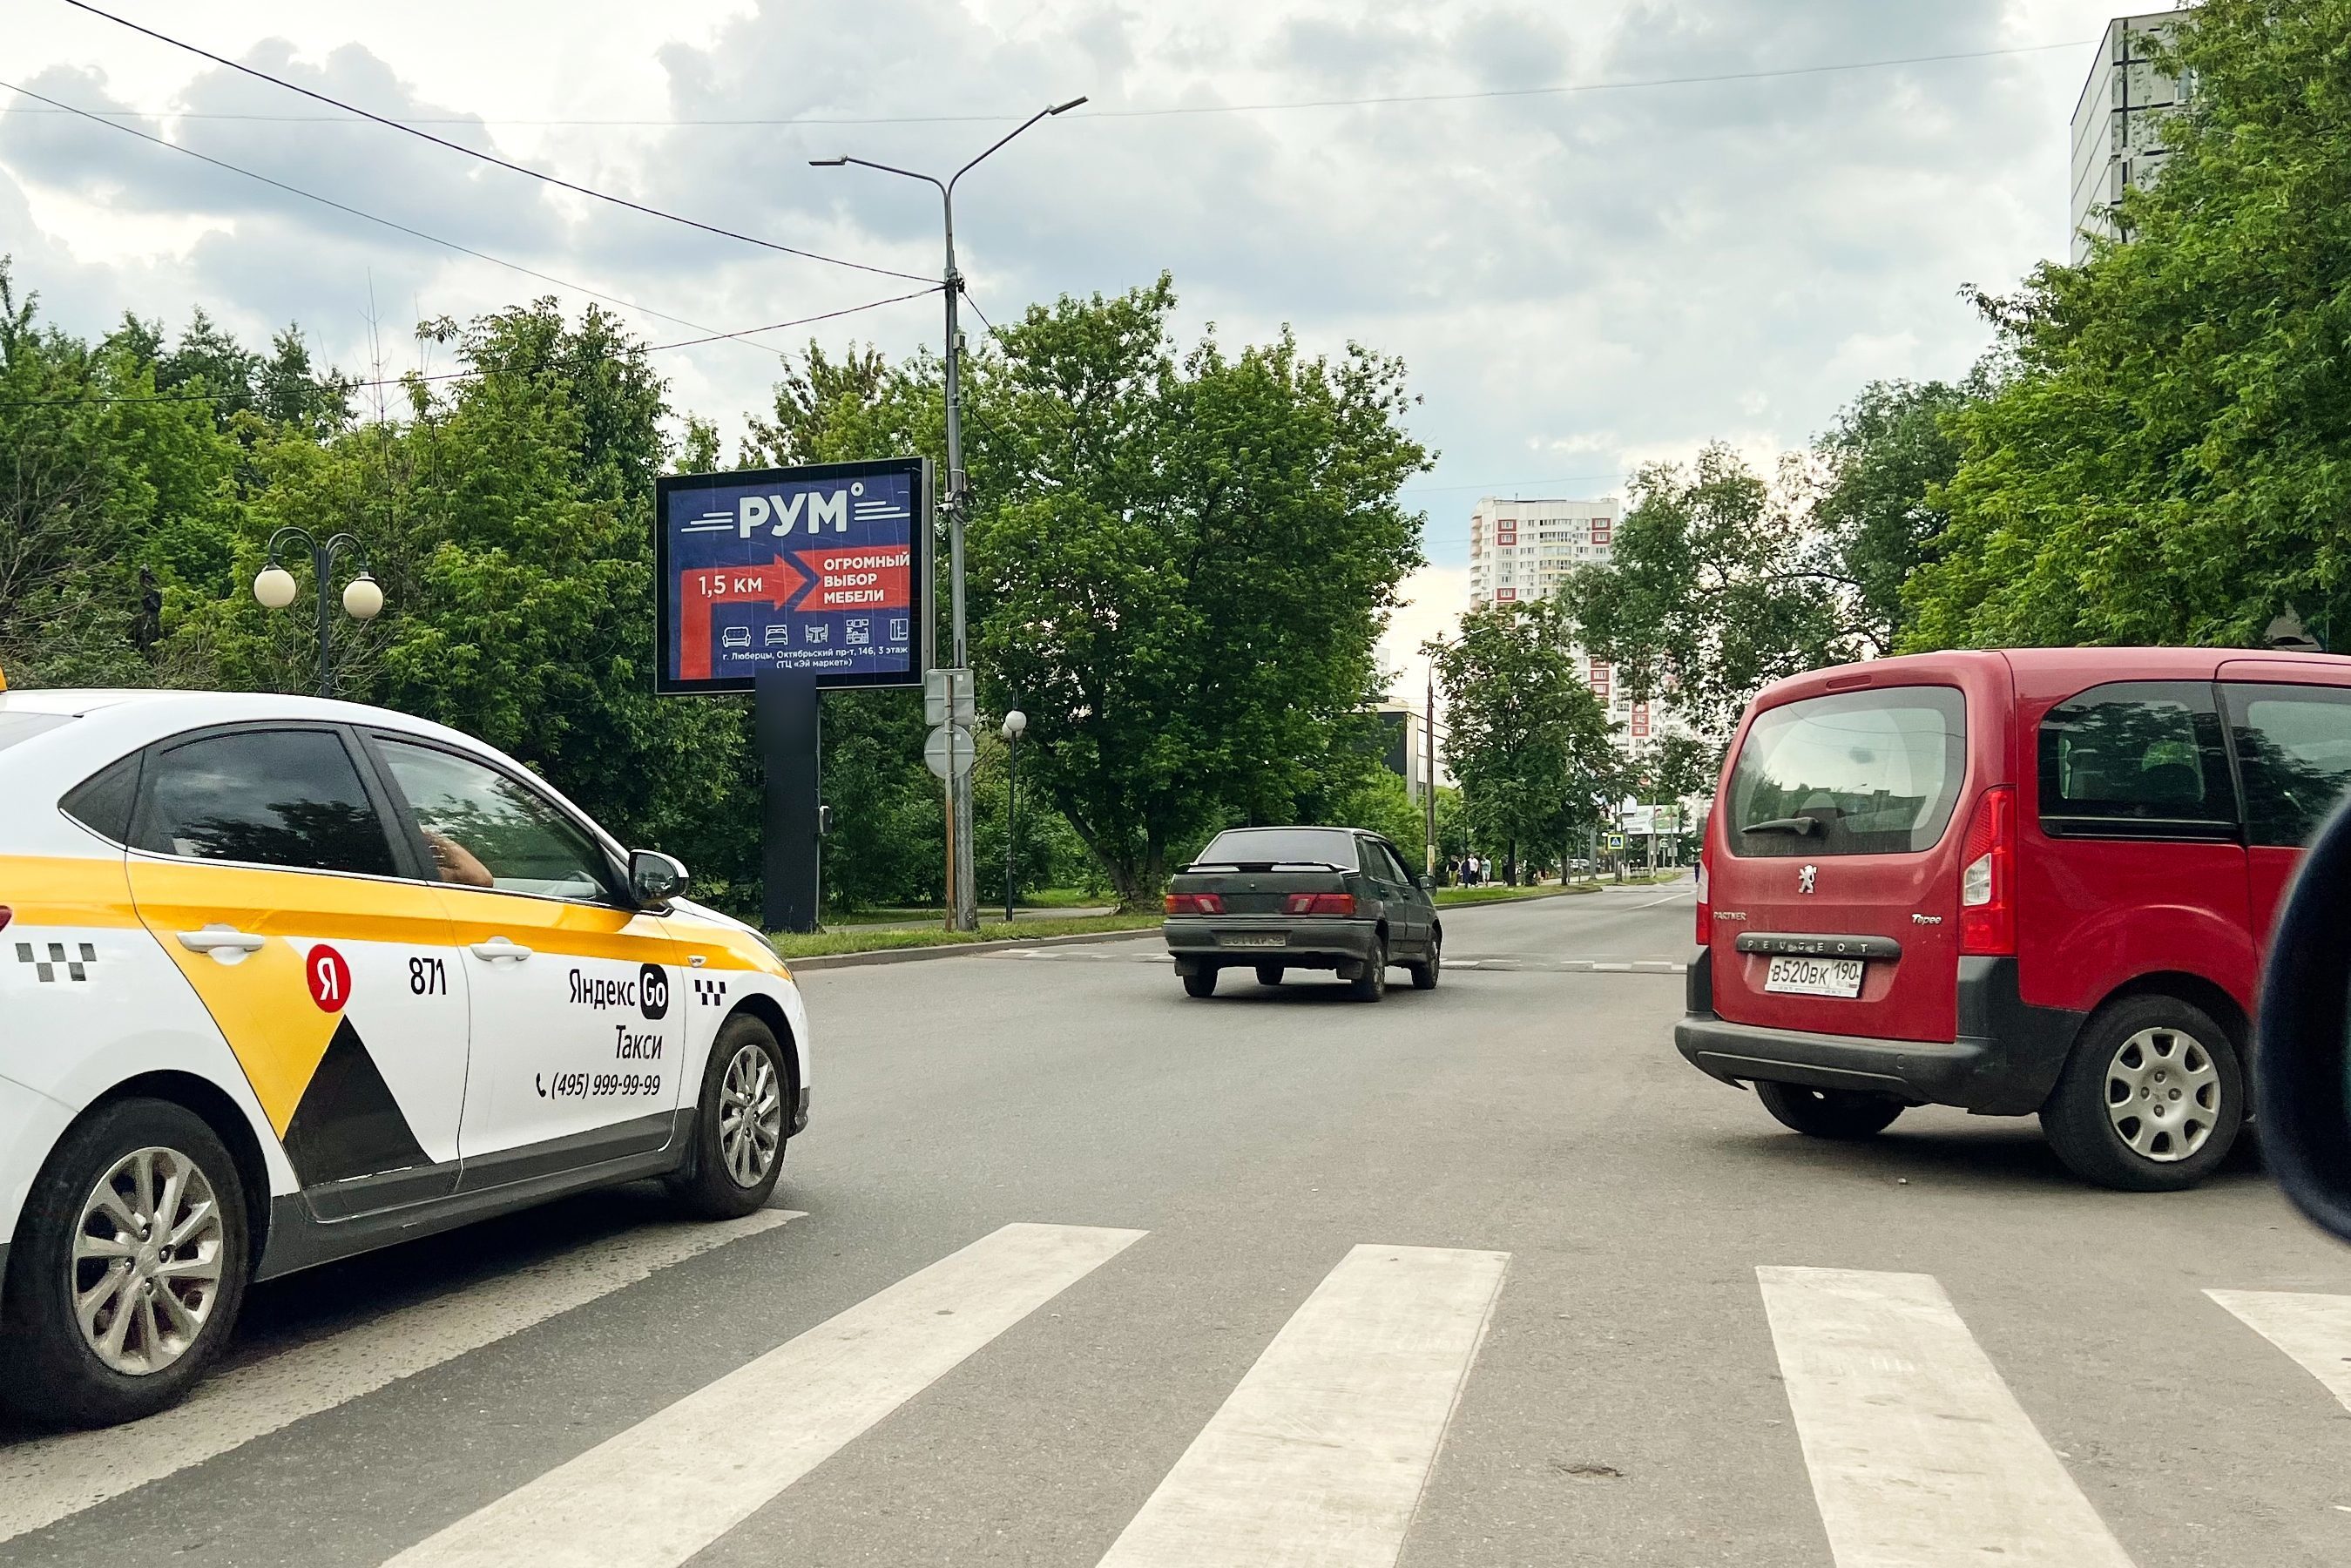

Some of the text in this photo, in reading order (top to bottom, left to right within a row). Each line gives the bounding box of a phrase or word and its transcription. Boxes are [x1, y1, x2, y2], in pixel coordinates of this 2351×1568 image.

[823, 552, 910, 571] ОГРОМНЫЙ
[698, 575, 726, 598] 1,5
[823, 573, 878, 588] ВЫБОР
[823, 590, 884, 604] МЕБЕЛИ
[731, 652, 775, 661] Люберцы,
[776, 648, 834, 659] Октябрьский
[835, 648, 857, 659] пр-т,
[858, 647, 876, 656] 146,
[885, 645, 909, 654] этаж
[776, 660, 792, 669] (ТЦ
[813, 659, 853, 669] маркет»)
[1713, 911, 1746, 921] PARTNER
[316, 956, 340, 1001] Я
[409, 956, 448, 996] 871
[569, 968, 666, 1010] Яндекс Go
[615, 1024, 662, 1060] Такси
[551, 1072, 660, 1098] (495) 999-99-99
